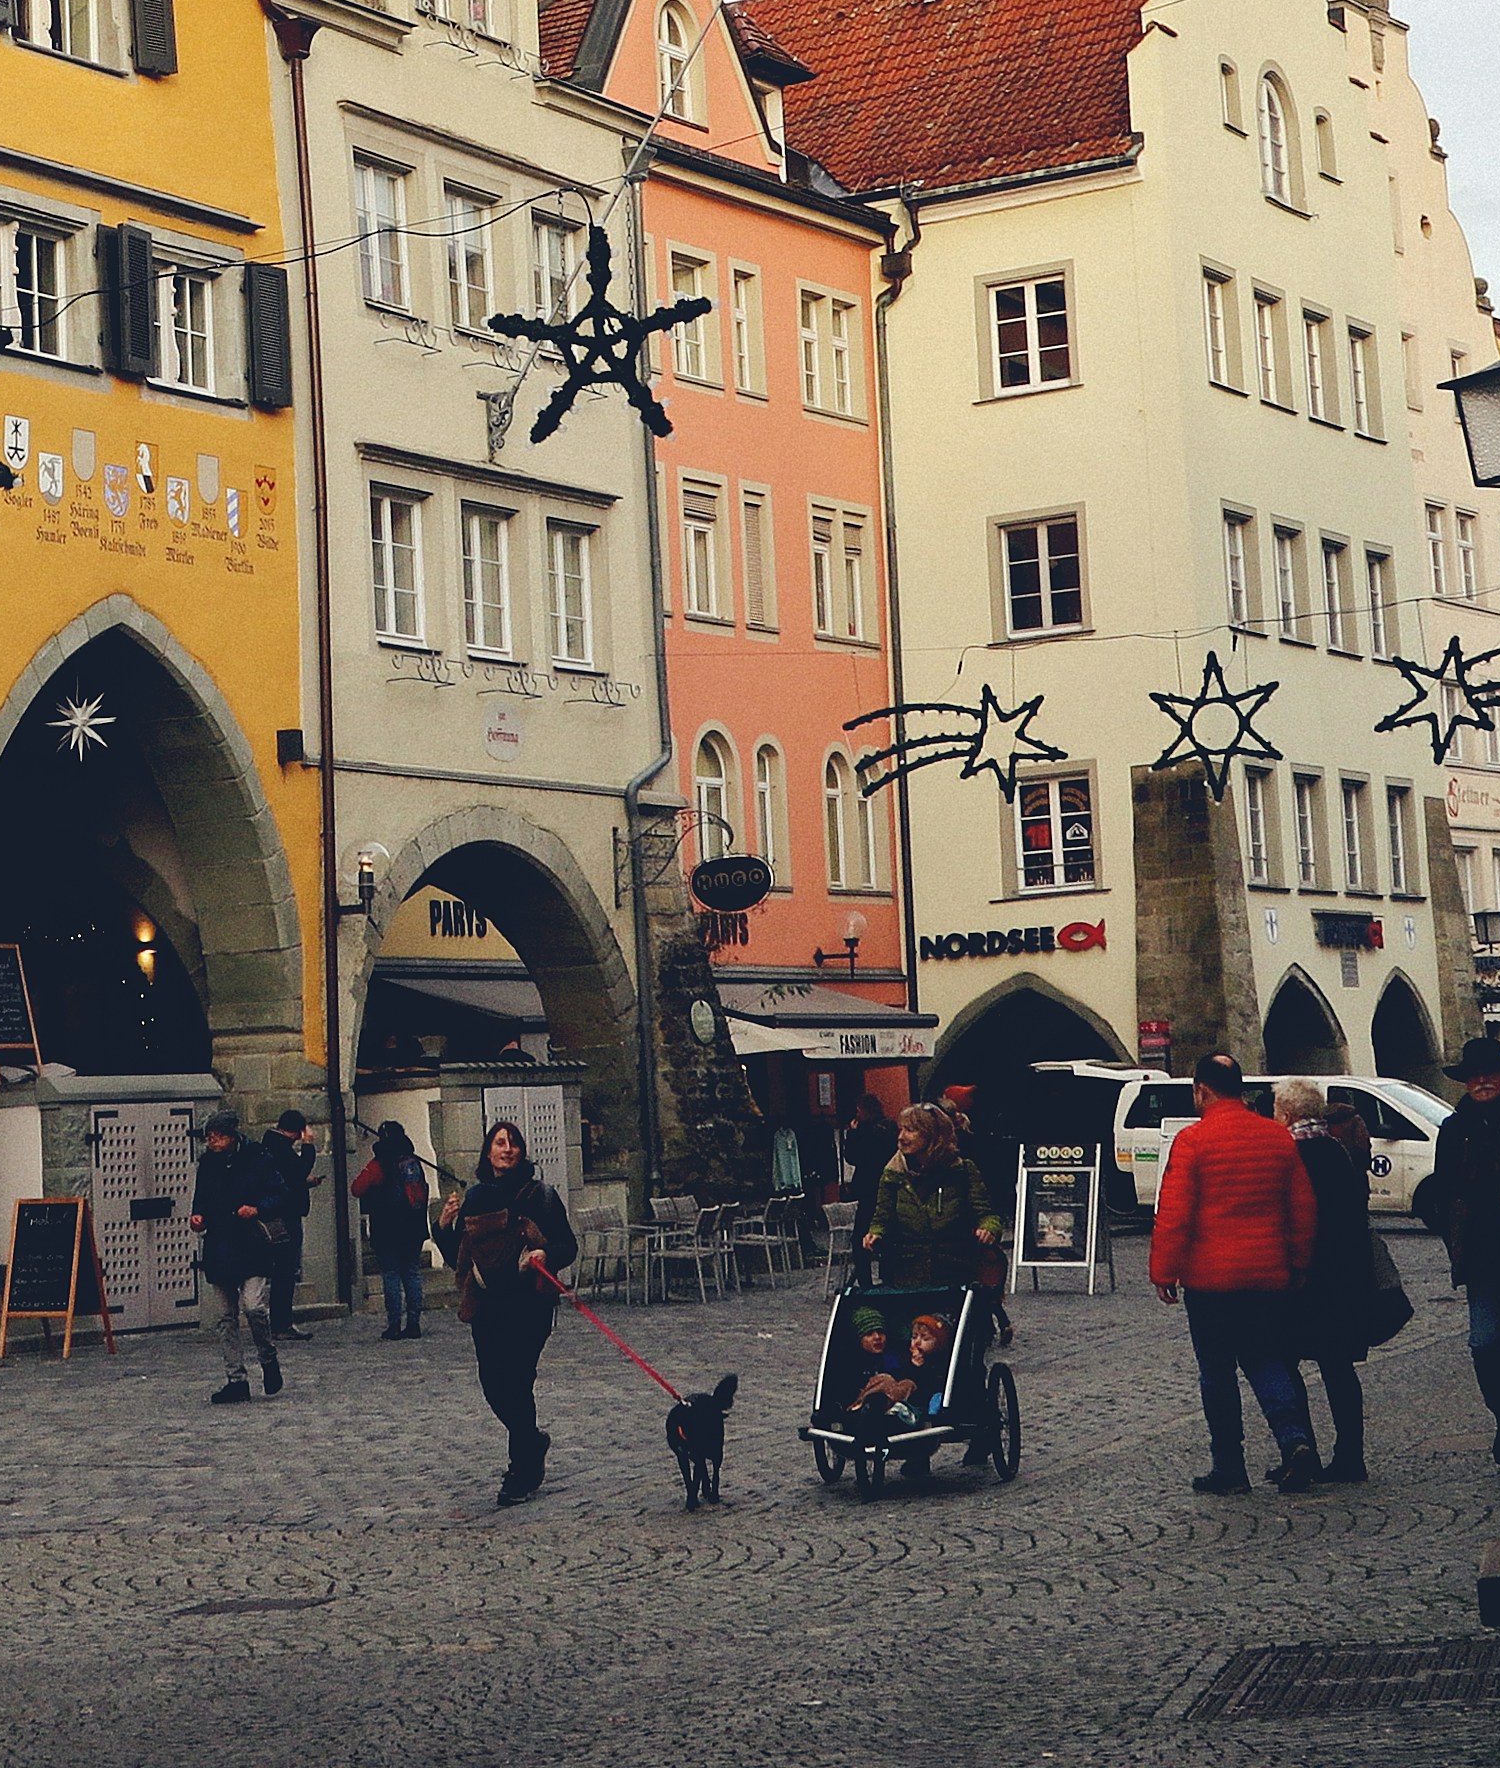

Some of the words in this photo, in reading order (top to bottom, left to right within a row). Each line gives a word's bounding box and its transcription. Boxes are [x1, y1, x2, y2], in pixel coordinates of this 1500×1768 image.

[696, 868, 765, 891] HUGO
[919, 926, 1054, 961] NORDSEE
[839, 1034, 877, 1055] FASHION
[1037, 1146, 1083, 1158] HUGO
